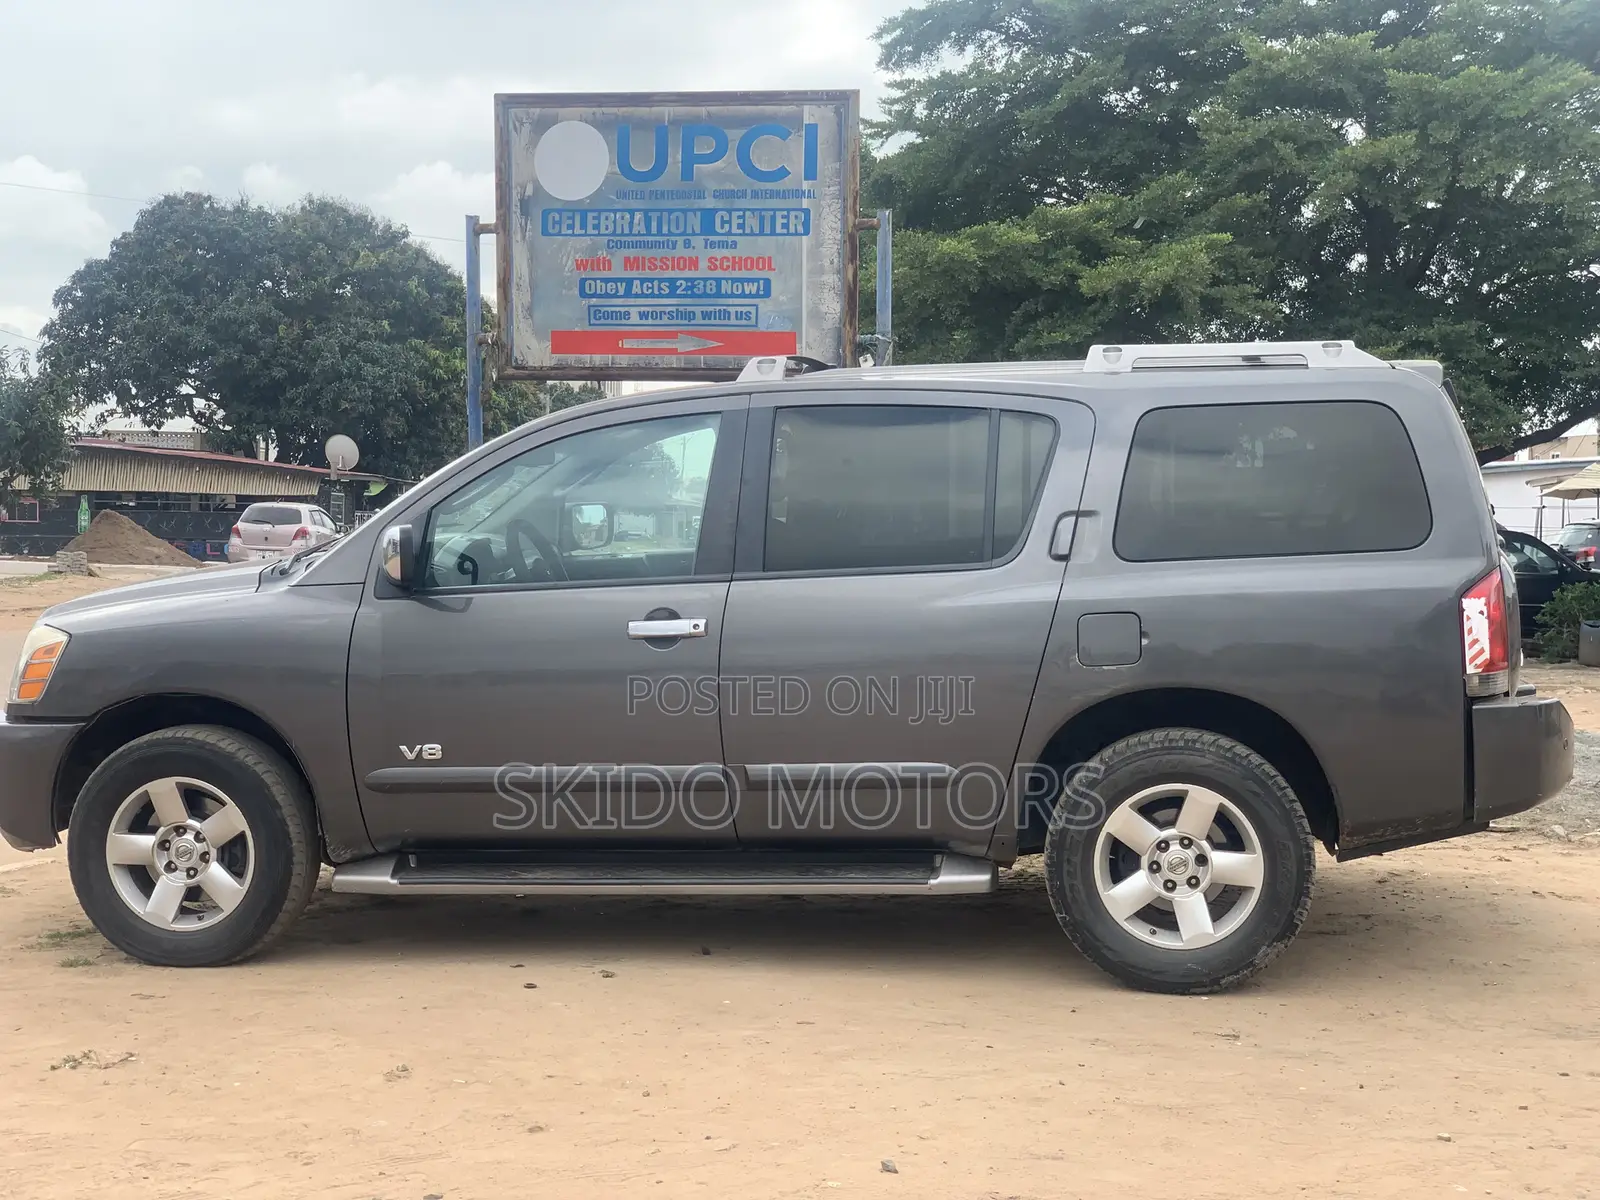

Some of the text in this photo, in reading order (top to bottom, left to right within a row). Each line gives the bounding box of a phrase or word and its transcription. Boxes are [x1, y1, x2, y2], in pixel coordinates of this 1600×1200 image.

[616, 123, 818, 182] UPCI
[616, 189, 645, 200] UNITED
[712, 189, 748, 200] CHURCH
[750, 189, 817, 200] INTERNATIONAL
[547, 211, 804, 235] CELEBRATION CENTER
[606, 238, 678, 250] Community
[702, 238, 738, 249] Tema
[575, 256, 776, 272] with MISSION SCHOOL
[584, 279, 765, 296] Obey Acts 2:38 Now!
[592, 308, 753, 323] Come worship with us
[398, 743, 442, 760] V8
